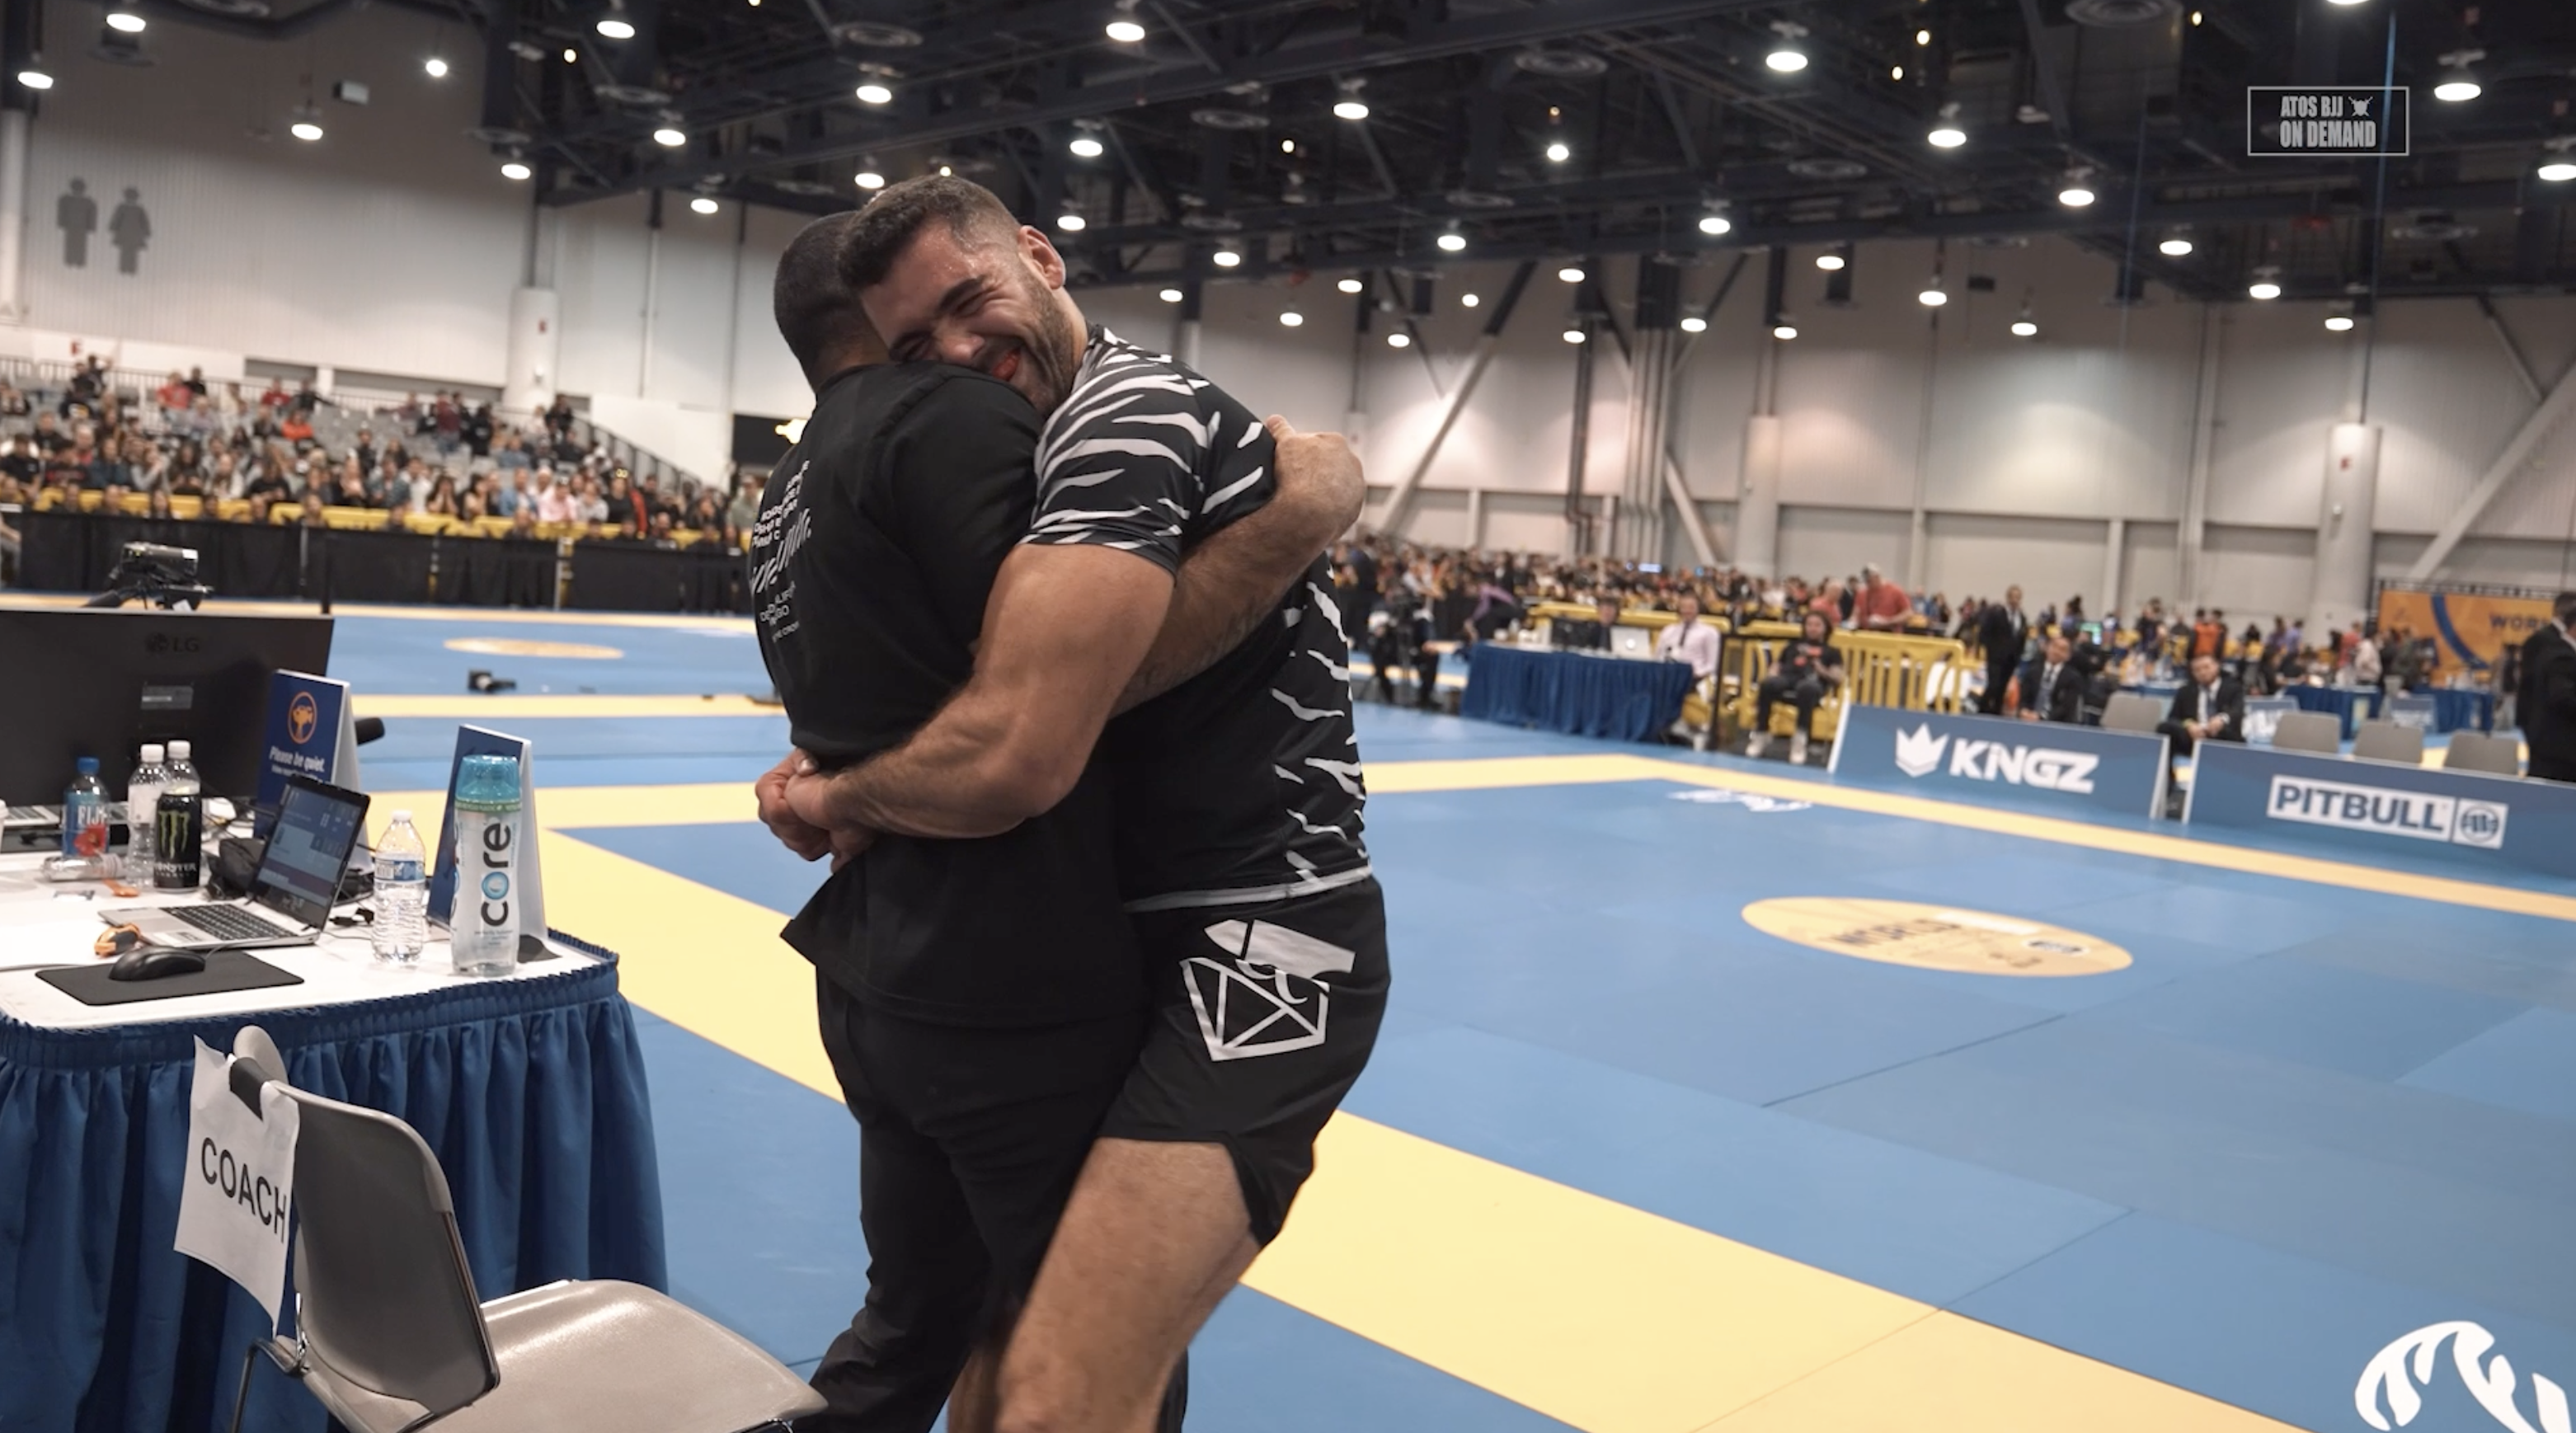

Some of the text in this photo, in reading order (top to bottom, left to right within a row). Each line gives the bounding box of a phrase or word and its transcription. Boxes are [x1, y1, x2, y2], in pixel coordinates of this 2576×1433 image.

[2489, 613, 2548, 631] WOR
[173, 637, 200, 653] LG
[269, 745, 294, 765] Please
[293, 751, 304, 768] be
[2275, 783, 2444, 833] PITBULL
[481, 822, 511, 927] core
[200, 1136, 287, 1244] COACH
